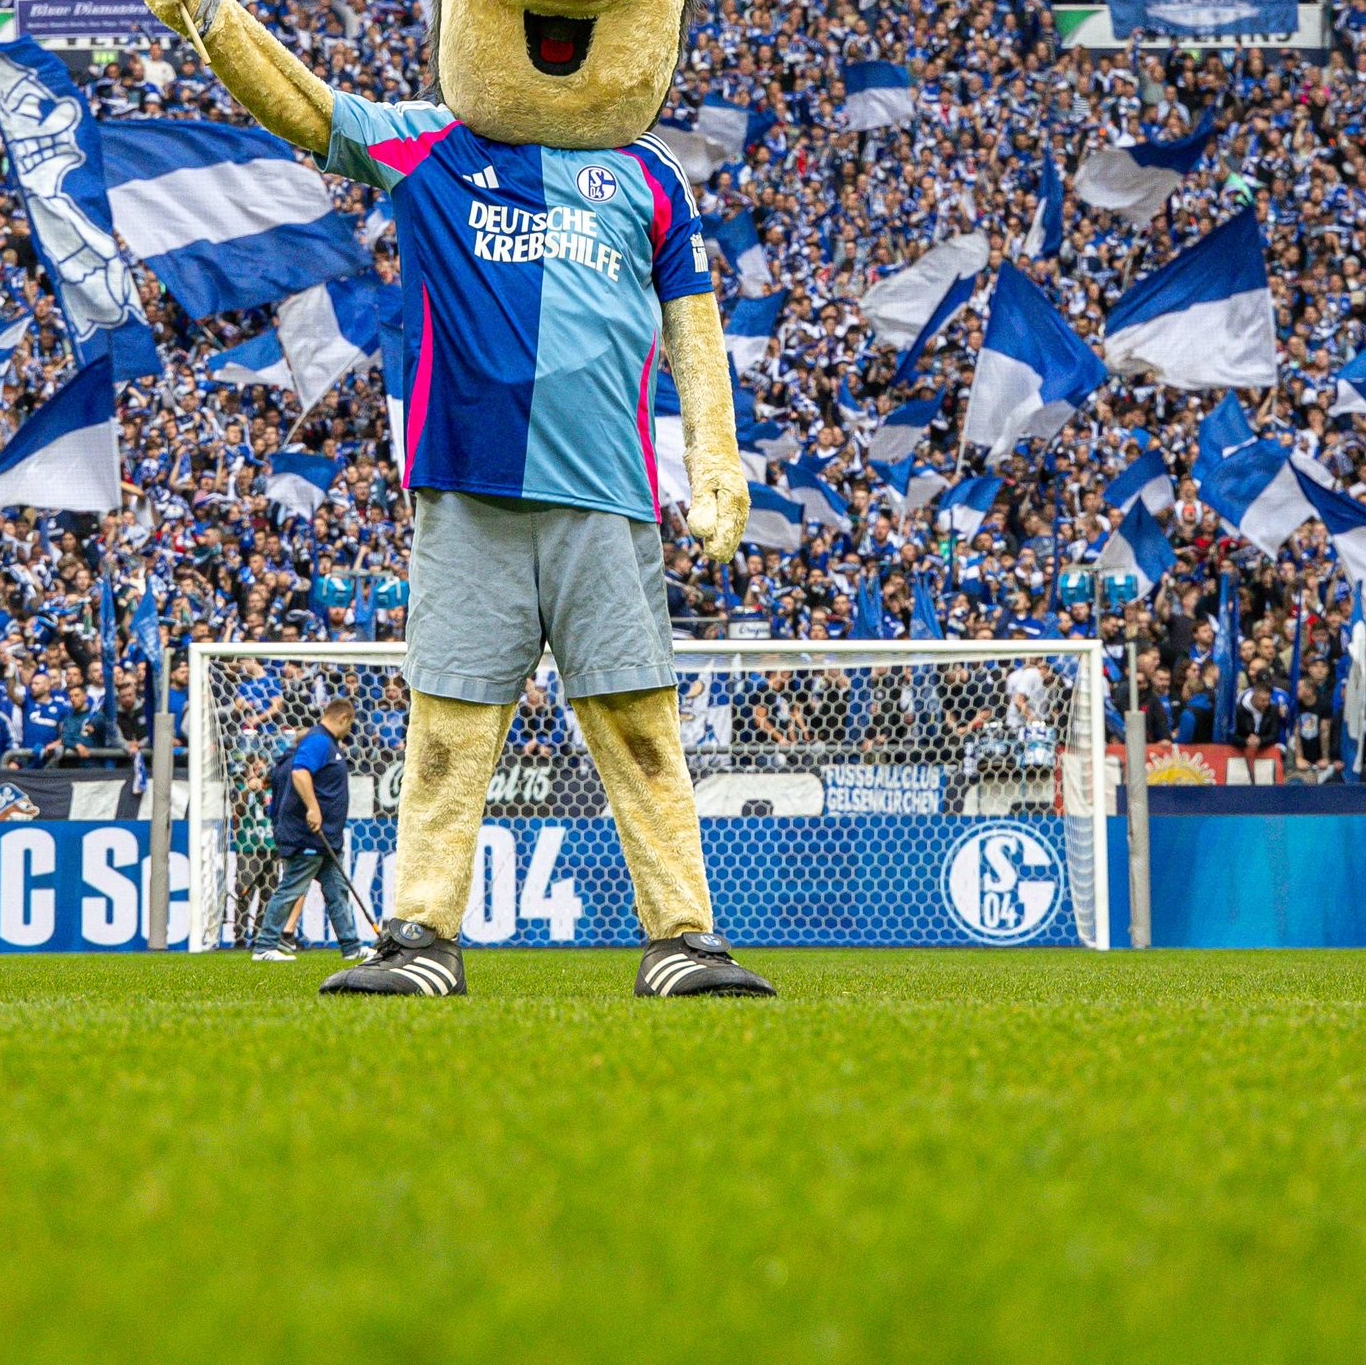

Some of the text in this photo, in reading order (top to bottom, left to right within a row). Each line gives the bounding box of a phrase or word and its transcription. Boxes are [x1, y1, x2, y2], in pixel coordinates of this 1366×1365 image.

[468, 200, 598, 238] DEUTSCHE
[474, 231, 623, 283] KREBSHILFE
[468, 825, 583, 944] 04
